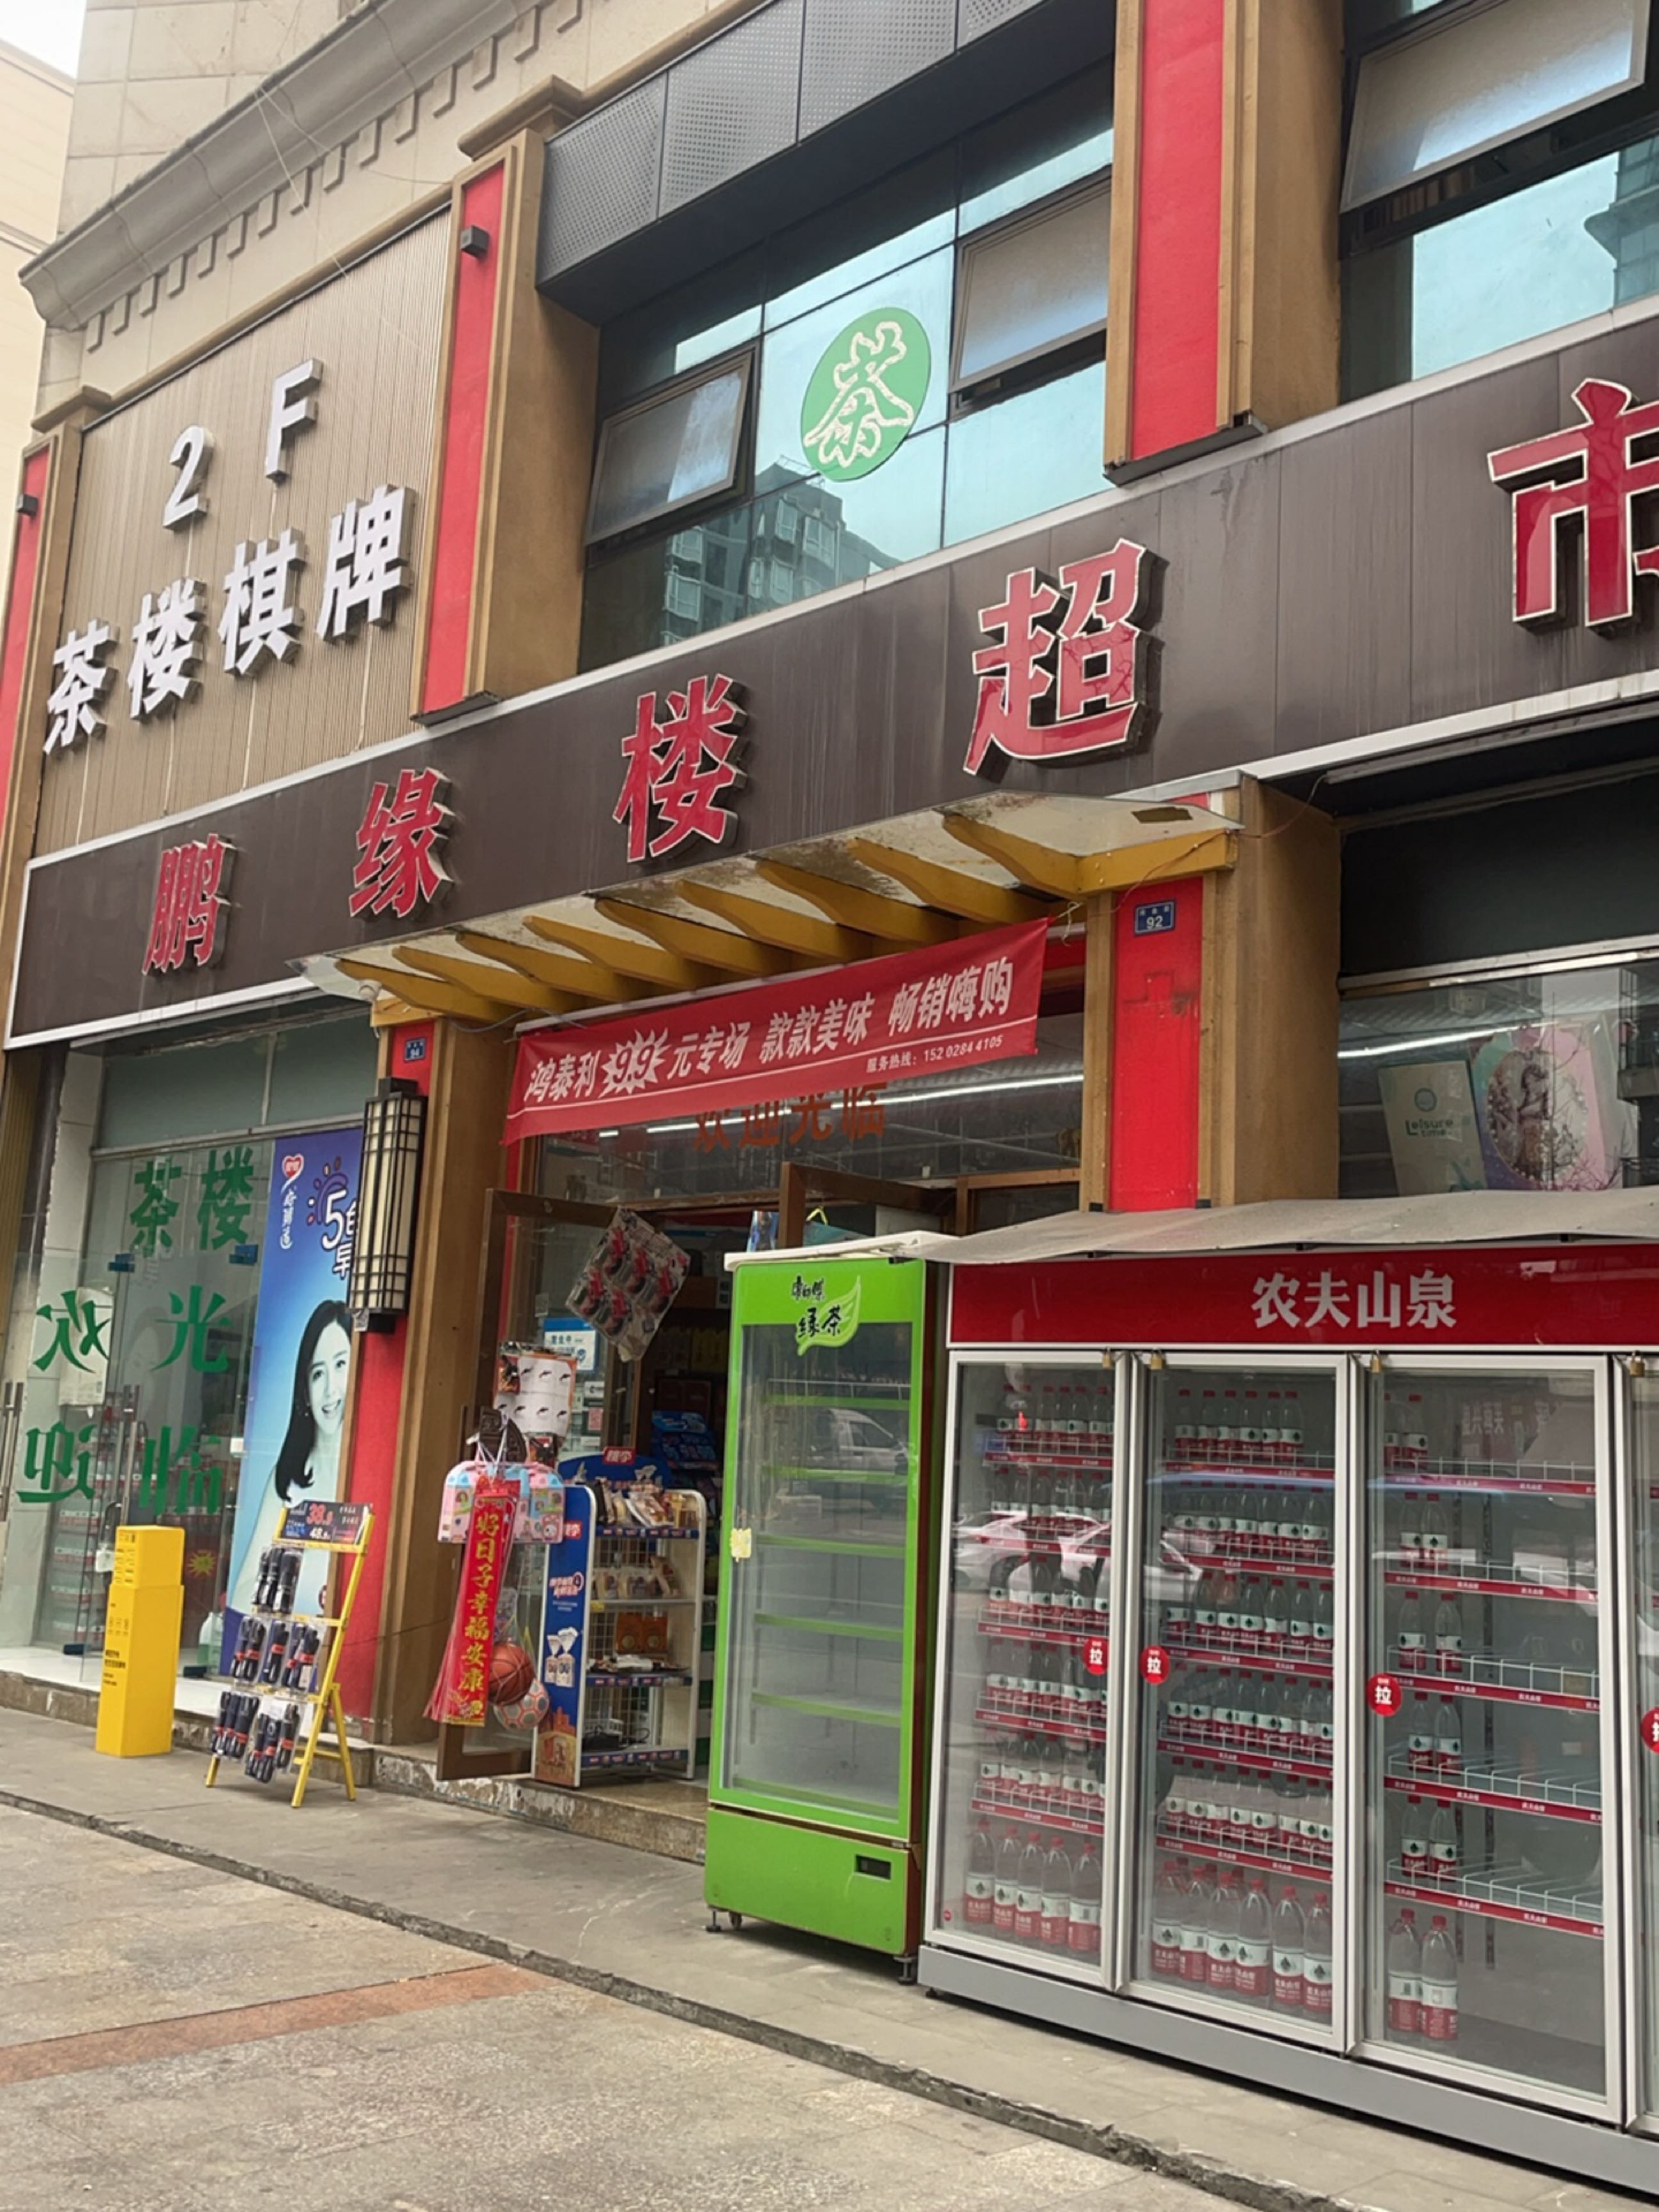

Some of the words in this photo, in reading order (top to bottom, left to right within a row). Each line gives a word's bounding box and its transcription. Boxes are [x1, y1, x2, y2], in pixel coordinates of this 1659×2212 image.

[803, 321, 915, 467] 茶
[163, 358, 323, 530] 2F
[43, 483, 416, 756] 茶楼棋牌
[142, 377, 1659, 976] 鹏缘楼超市
[1147, 916, 1163, 930] 92
[759, 991, 876, 1064] 款款美味
[888, 956, 1013, 1037] 畅销嗨购
[924, 1048, 943, 1062] 152
[975, 1034, 1004, 1052] 4105
[129, 1146, 255, 1257] 茶楼
[798, 1304, 842, 1338] 绿茶
[1250, 1269, 1457, 1329] 农夫山泉
[457, 1512, 500, 1692] 好日子幸福安康
[1090, 1648, 1103, 1665] 拉
[1148, 1656, 1162, 1674] 拉
[1375, 1685, 1392, 1705] 拉
